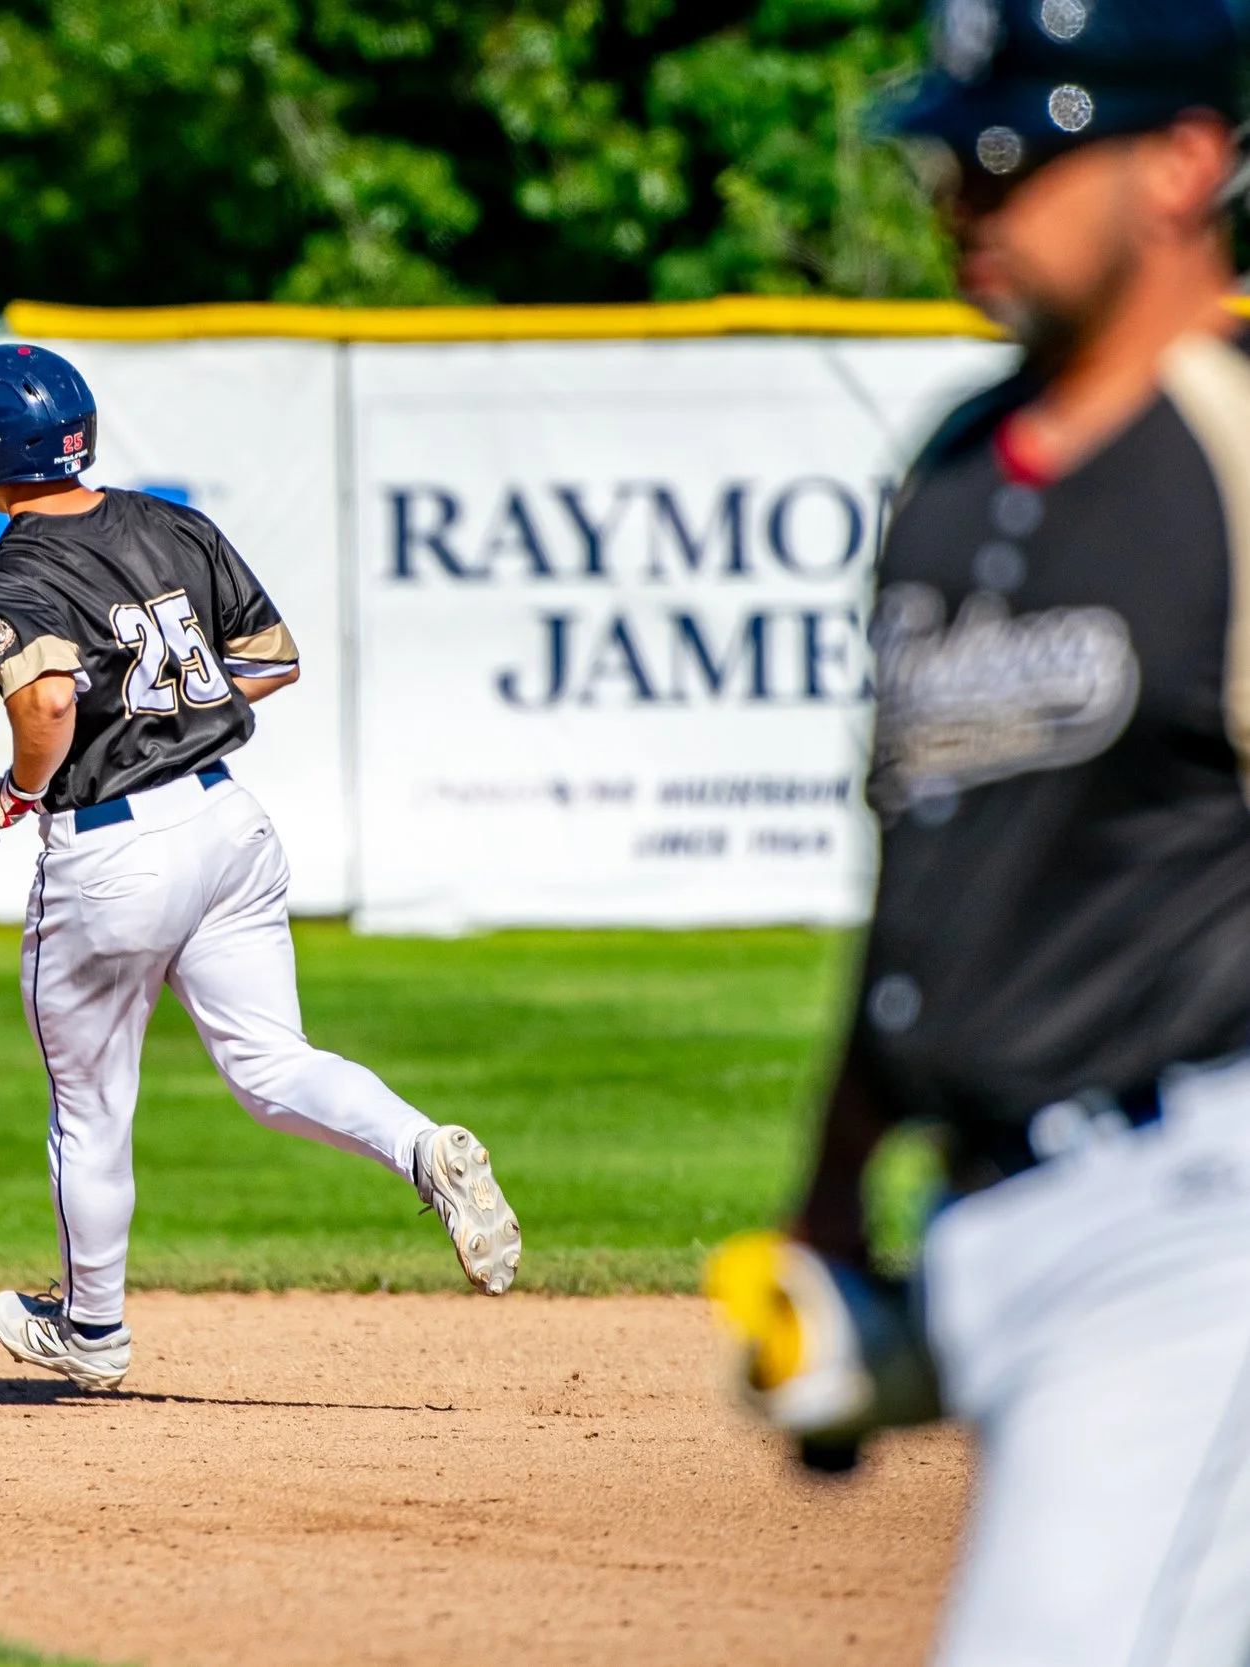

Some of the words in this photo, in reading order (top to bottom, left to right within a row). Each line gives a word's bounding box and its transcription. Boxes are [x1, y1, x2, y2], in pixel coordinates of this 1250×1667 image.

[63, 431, 84, 455] 25
[109, 588, 232, 719] 25
[494, 606, 876, 710] JAME
